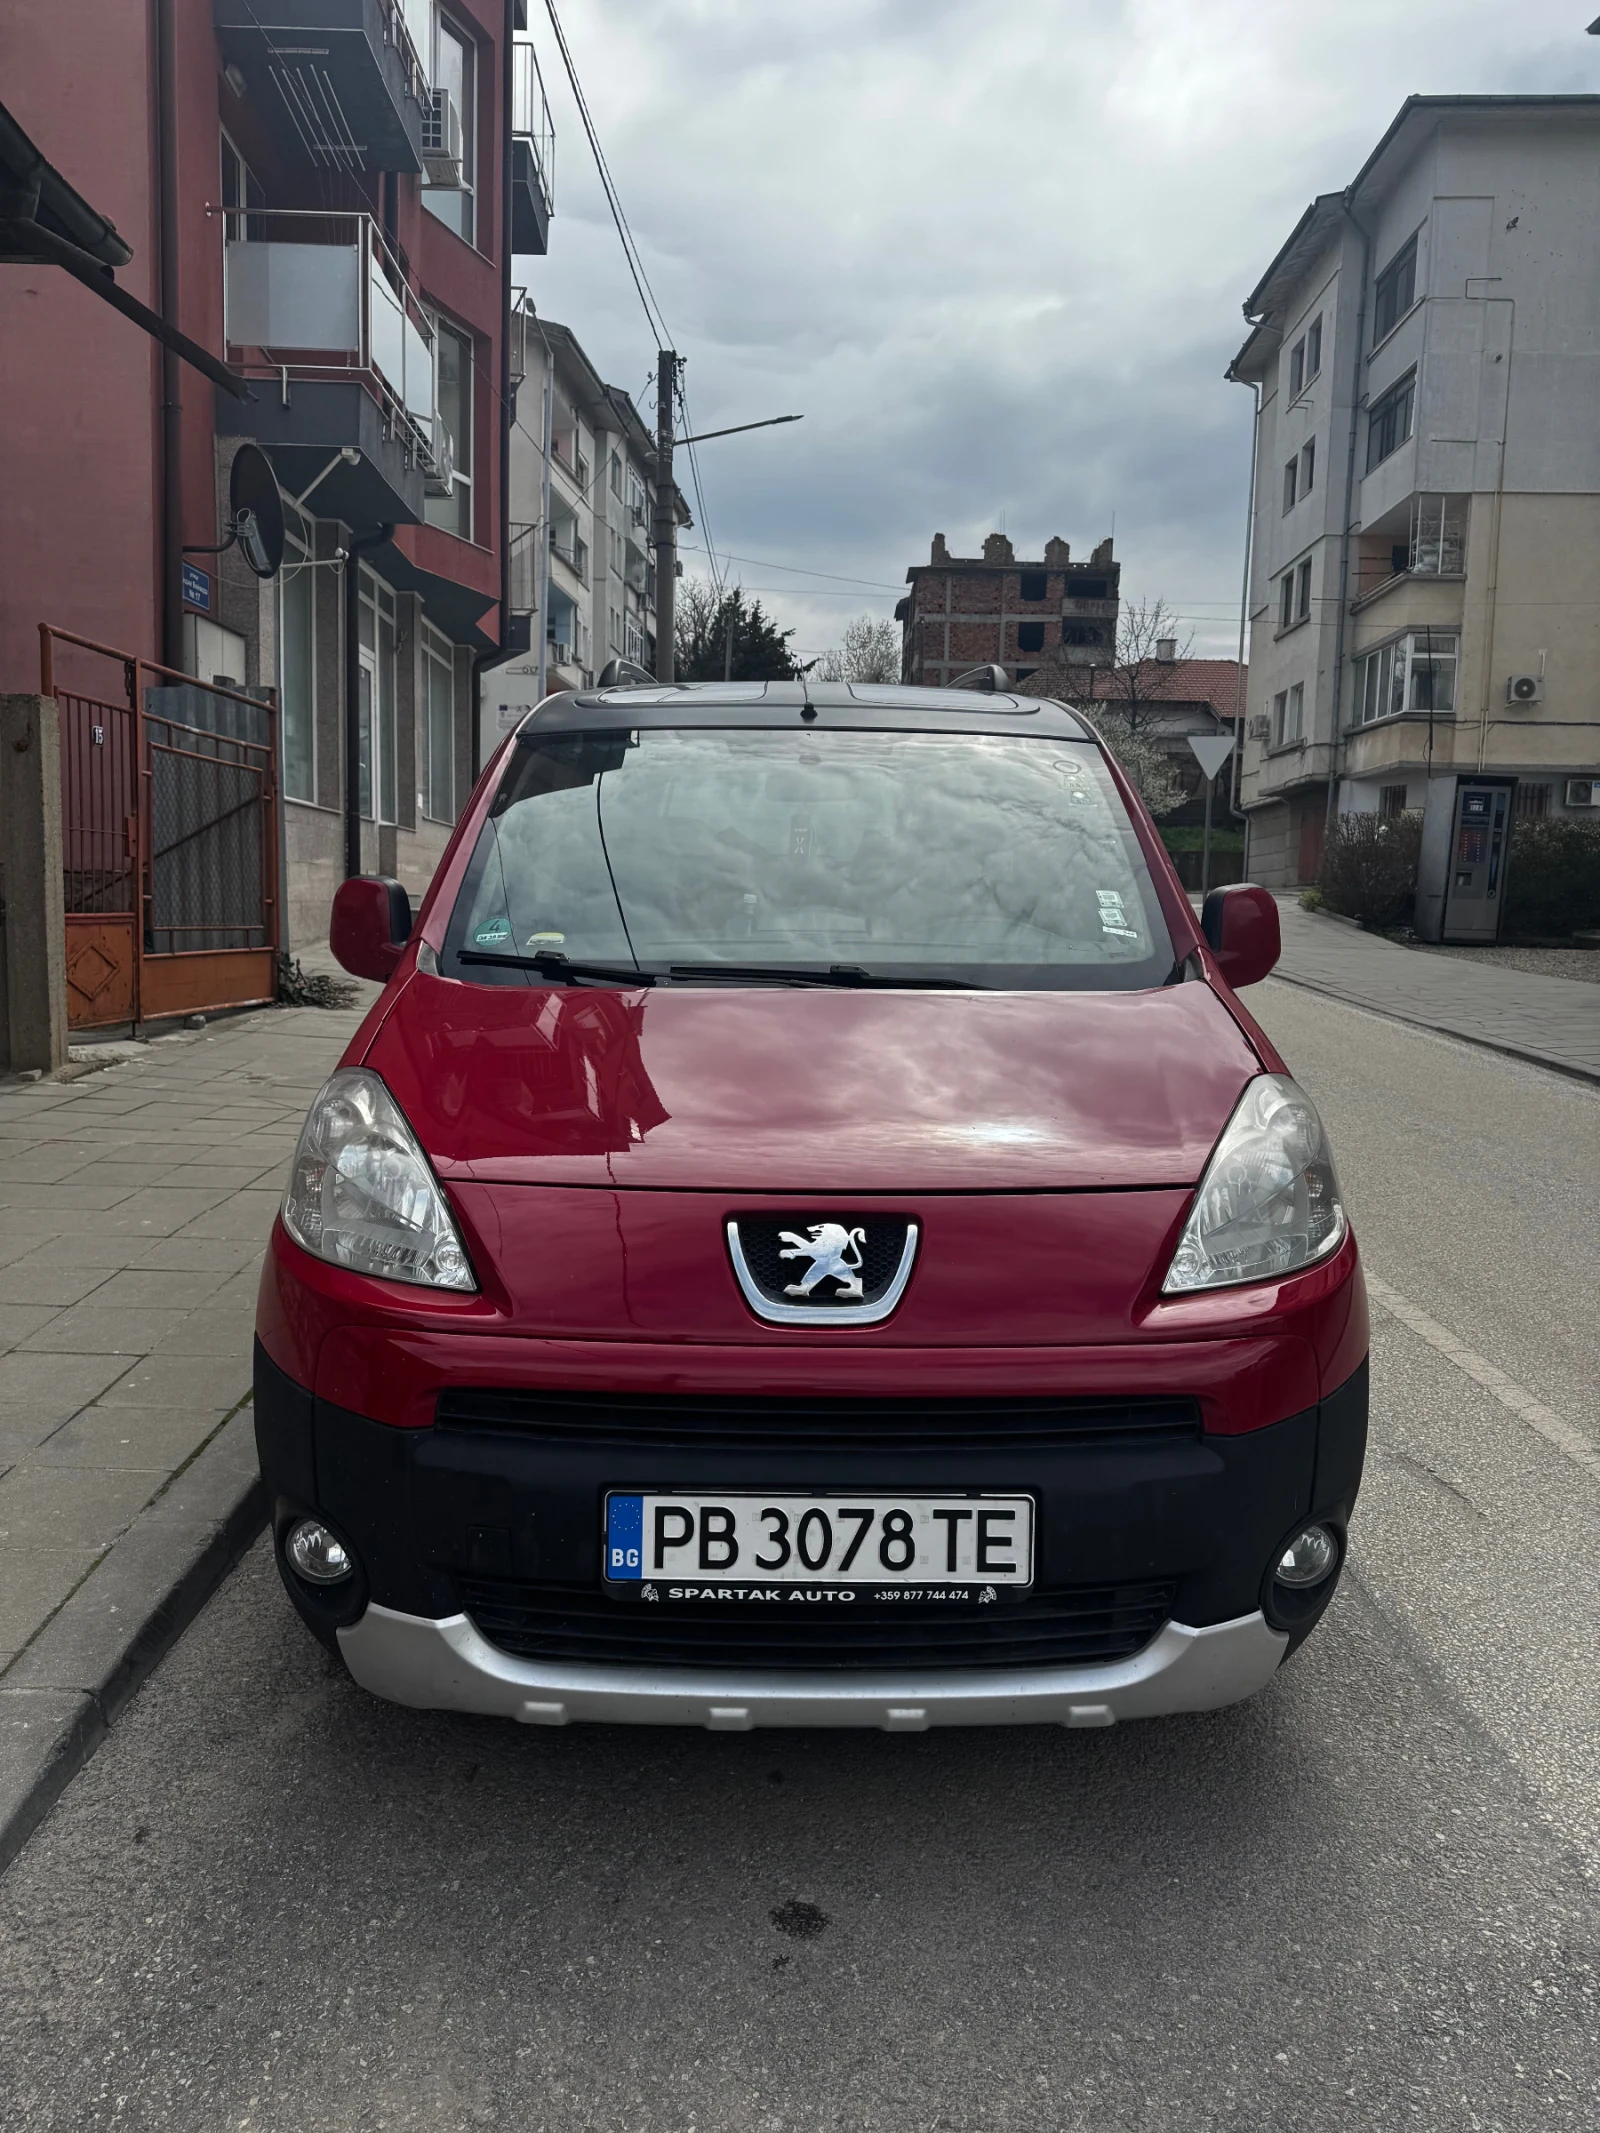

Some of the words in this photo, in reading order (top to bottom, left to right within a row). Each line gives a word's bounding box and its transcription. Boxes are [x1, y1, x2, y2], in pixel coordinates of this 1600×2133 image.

[195, 592, 200, 601] 17
[95, 728, 103, 744] 15
[488, 919, 501, 933] 4
[653, 1506, 739, 1570] PB
[755, 1507, 915, 1572] 3078
[933, 1509, 1016, 1573] TE
[611, 1548, 639, 1567] BG
[668, 1587, 781, 1602] SPARTAK
[788, 1589, 856, 1602] AUTO
[873, 1590, 900, 1601] +359
[903, 1590, 923, 1601] 877
[925, 1590, 946, 1601] 744
[948, 1590, 969, 1601] 474
